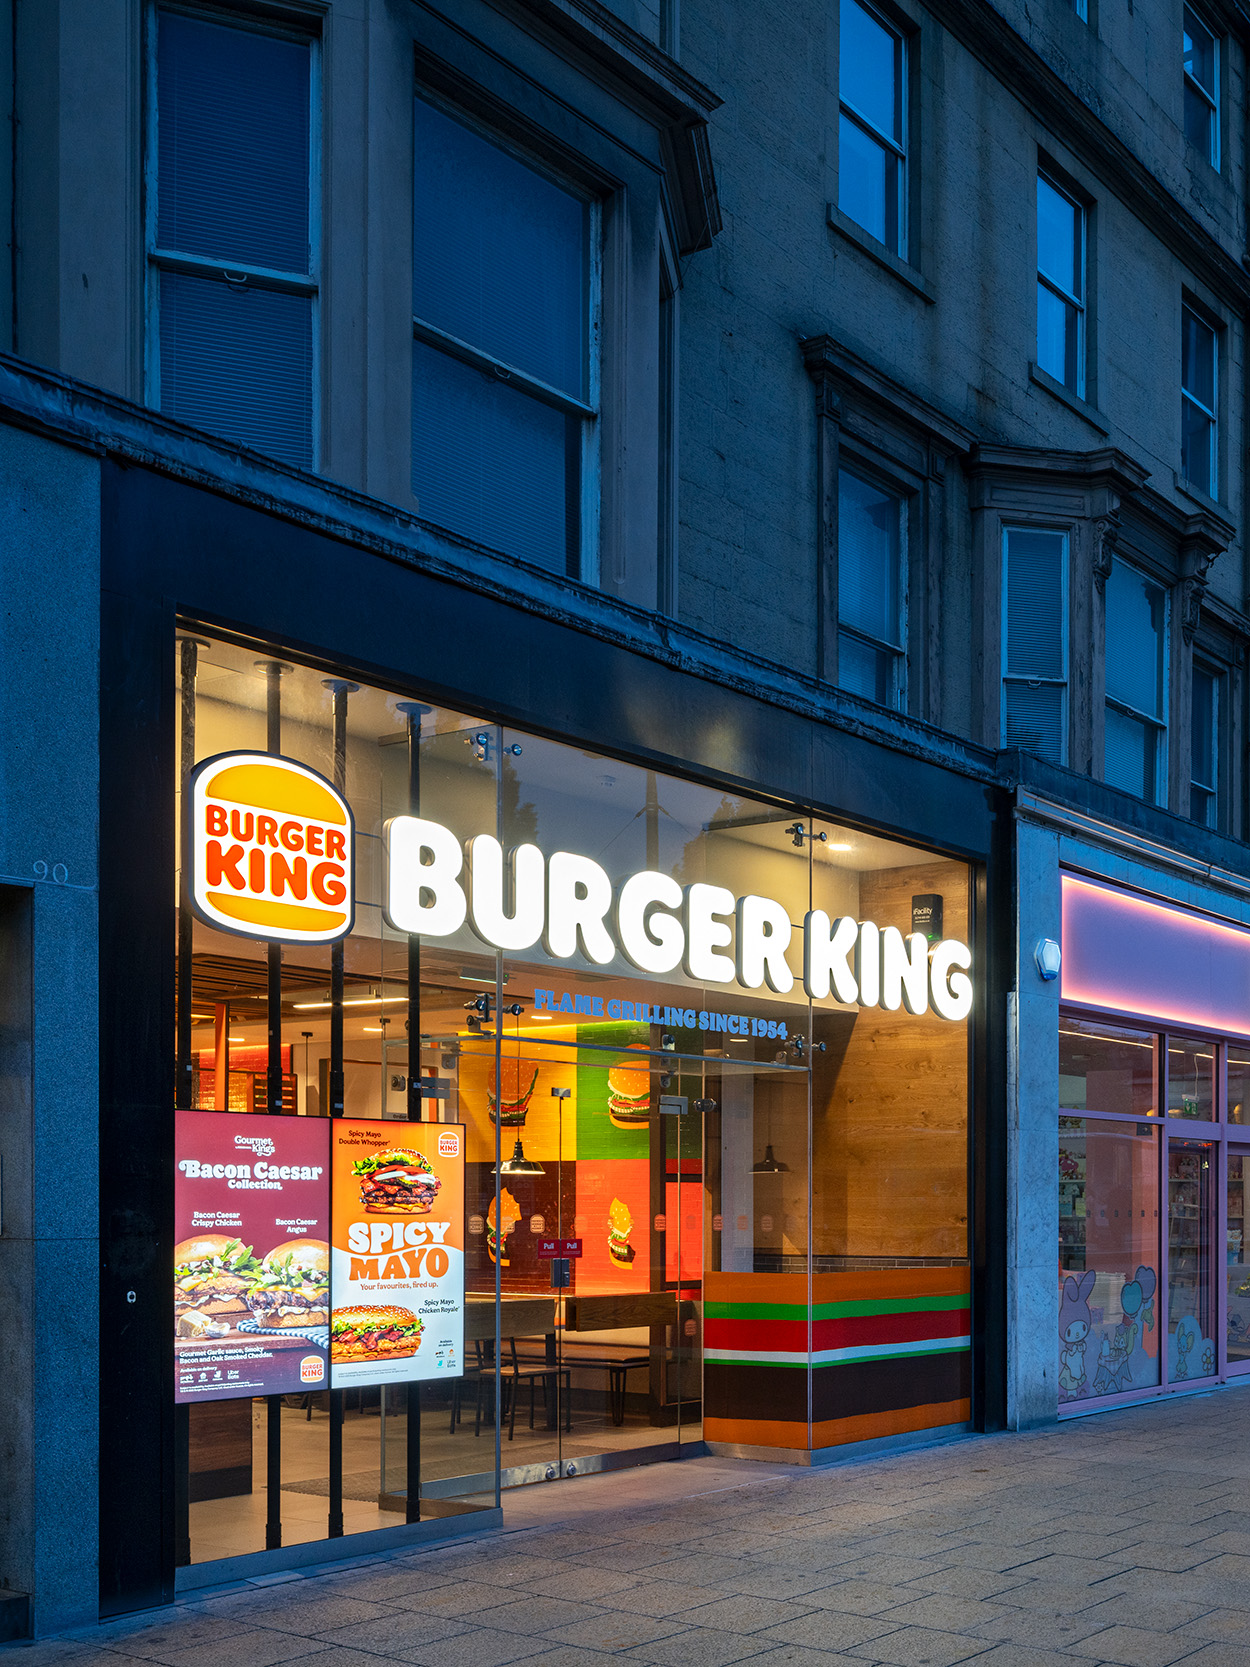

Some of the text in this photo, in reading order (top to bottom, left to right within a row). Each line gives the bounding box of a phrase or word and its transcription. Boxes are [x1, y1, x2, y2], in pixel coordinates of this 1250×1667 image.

[205, 804, 347, 861] BURGER
[33, 860, 68, 884] 90
[205, 840, 347, 906] KING
[382, 815, 974, 1021] BURGER KING
[534, 988, 788, 1040] FLAME GRILLING SINCE 1954
[348, 1130, 364, 1138] Spicy
[234, 1135, 274, 1146] Gourmet
[252, 1144, 276, 1156] Kings
[178, 1160, 323, 1180] Bacon Caesar
[227, 1179, 283, 1190] Collection
[193, 1211, 240, 1219] Bacon Caesar
[191, 1219, 243, 1228] Crispy Chicken
[286, 1226, 308, 1234] Angus
[348, 1221, 451, 1254] SPICY
[348, 1247, 449, 1281] MAYO
[424, 1299, 440, 1307] Spicy
[418, 1306, 441, 1314] Chicken
[301, 1369, 323, 1377] KING
